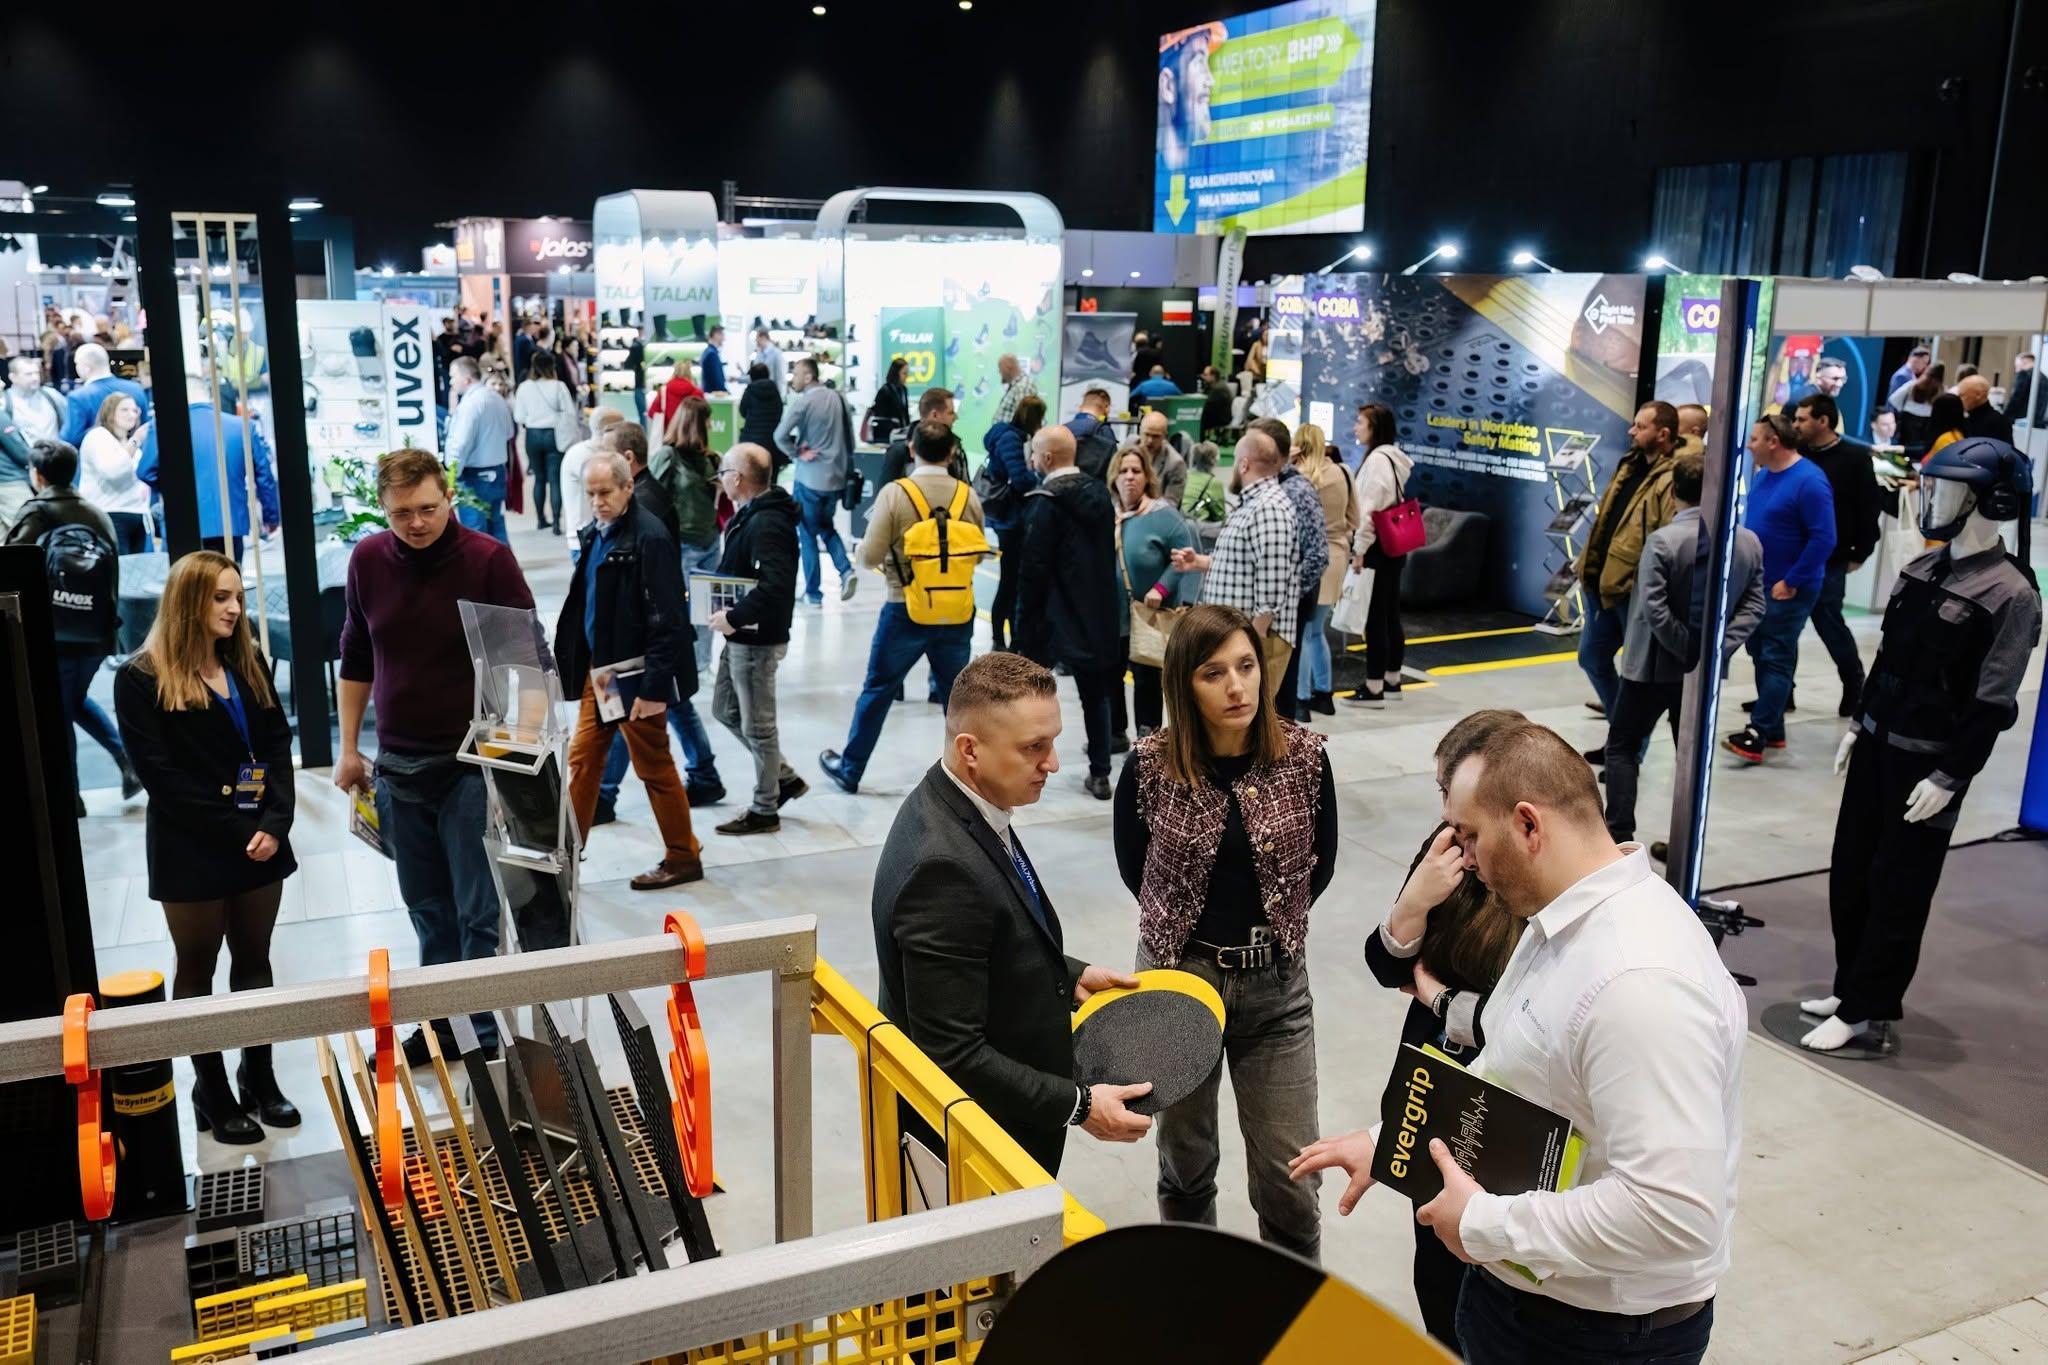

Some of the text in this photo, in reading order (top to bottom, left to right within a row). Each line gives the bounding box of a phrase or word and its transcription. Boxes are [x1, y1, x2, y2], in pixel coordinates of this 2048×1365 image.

[1287, 34, 1324, 64] BHP
[650, 287, 713, 301] TALAN
[1318, 296, 1359, 318] COBA
[1687, 303, 1720, 329] CO
[900, 332, 934, 344] TALAN
[392, 315, 424, 426] uvex
[1426, 411, 1538, 438] Leaders in Workplace
[1463, 430, 1541, 457] Safety Matting
[53, 589, 93, 606] uvex
[1390, 1067, 1434, 1178] evergrip
